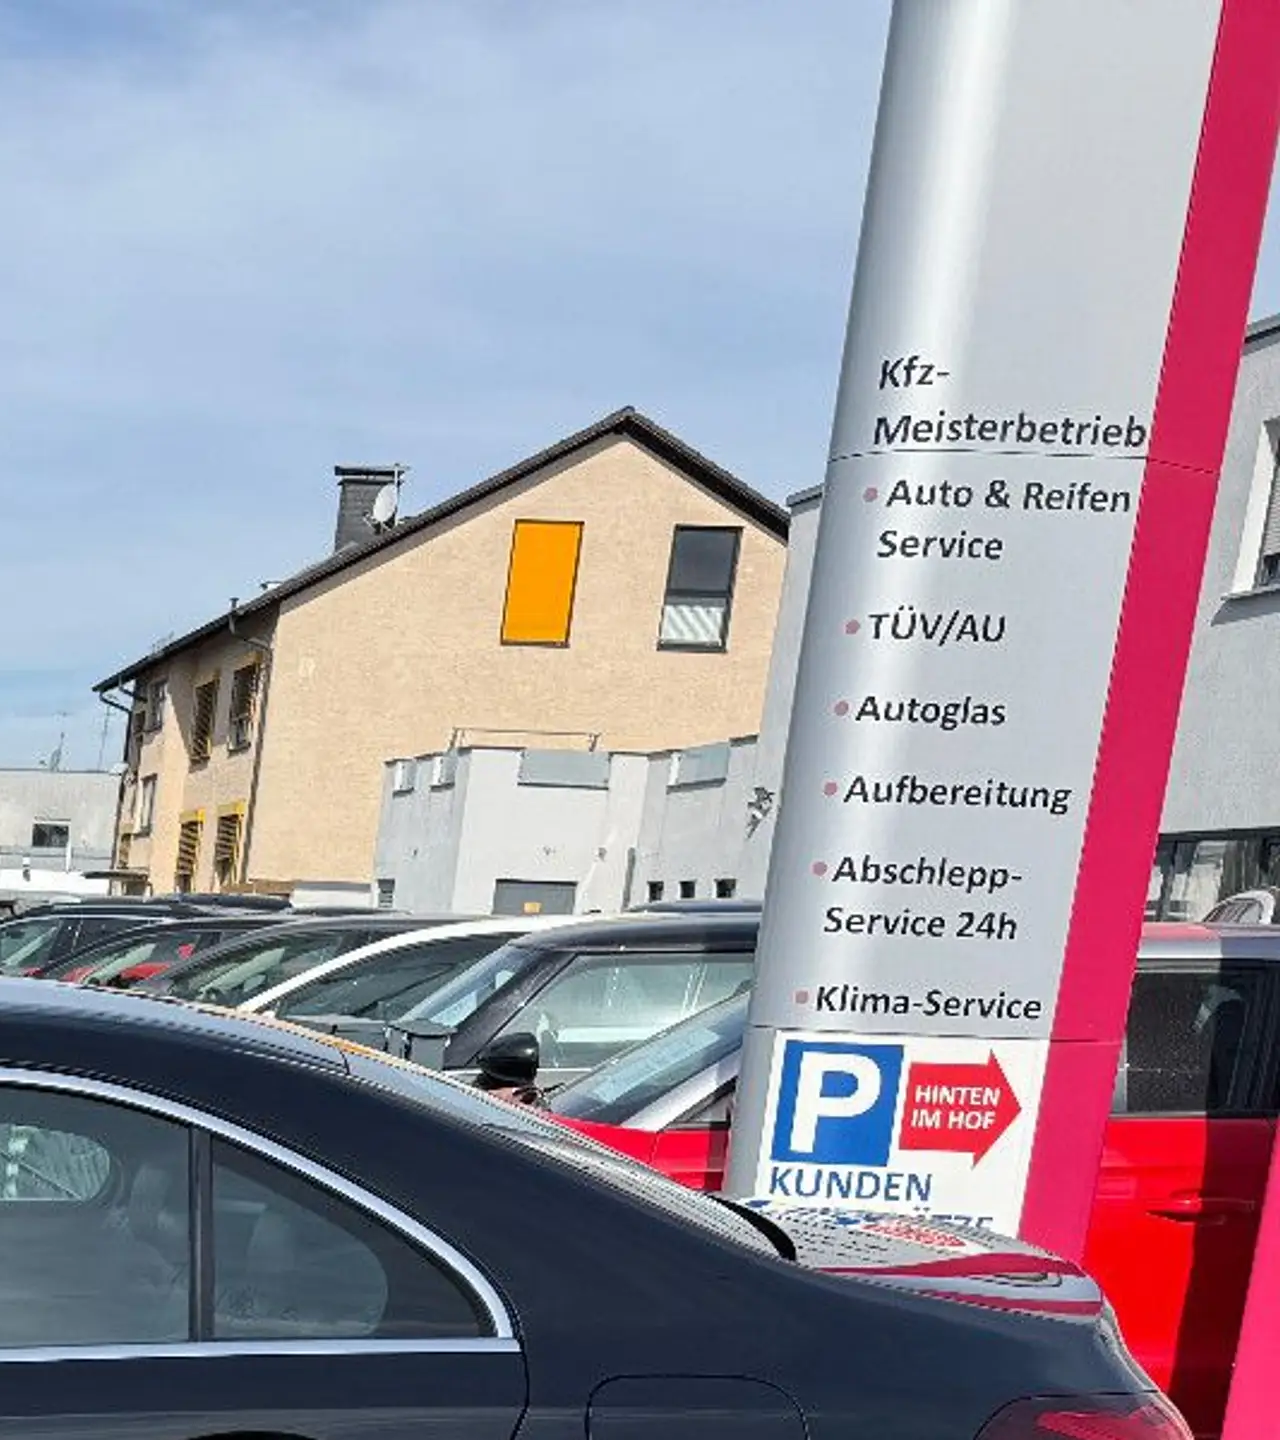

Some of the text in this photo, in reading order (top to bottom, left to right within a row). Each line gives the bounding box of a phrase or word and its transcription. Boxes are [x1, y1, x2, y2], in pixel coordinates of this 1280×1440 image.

[878, 356, 950, 391] Kfz-
[873, 411, 1147, 449] Meisterbetrieb
[886, 479, 1132, 513] Auto & Reifen
[876, 529, 1004, 560] Service
[868, 605, 1007, 647] TÜV/AU
[855, 696, 1007, 731] Autoglas
[844, 775, 1072, 816] Aufbereitung
[832, 856, 1023, 895] Abschlepp-
[823, 907, 1017, 940] Service 24h
[815, 984, 1042, 1021] Klima-Service
[789, 1050, 882, 1154] P
[914, 1083, 1001, 1108] HINTEN
[910, 1108, 997, 1131] IM HOF
[768, 1166, 932, 1202] KUNDEN
